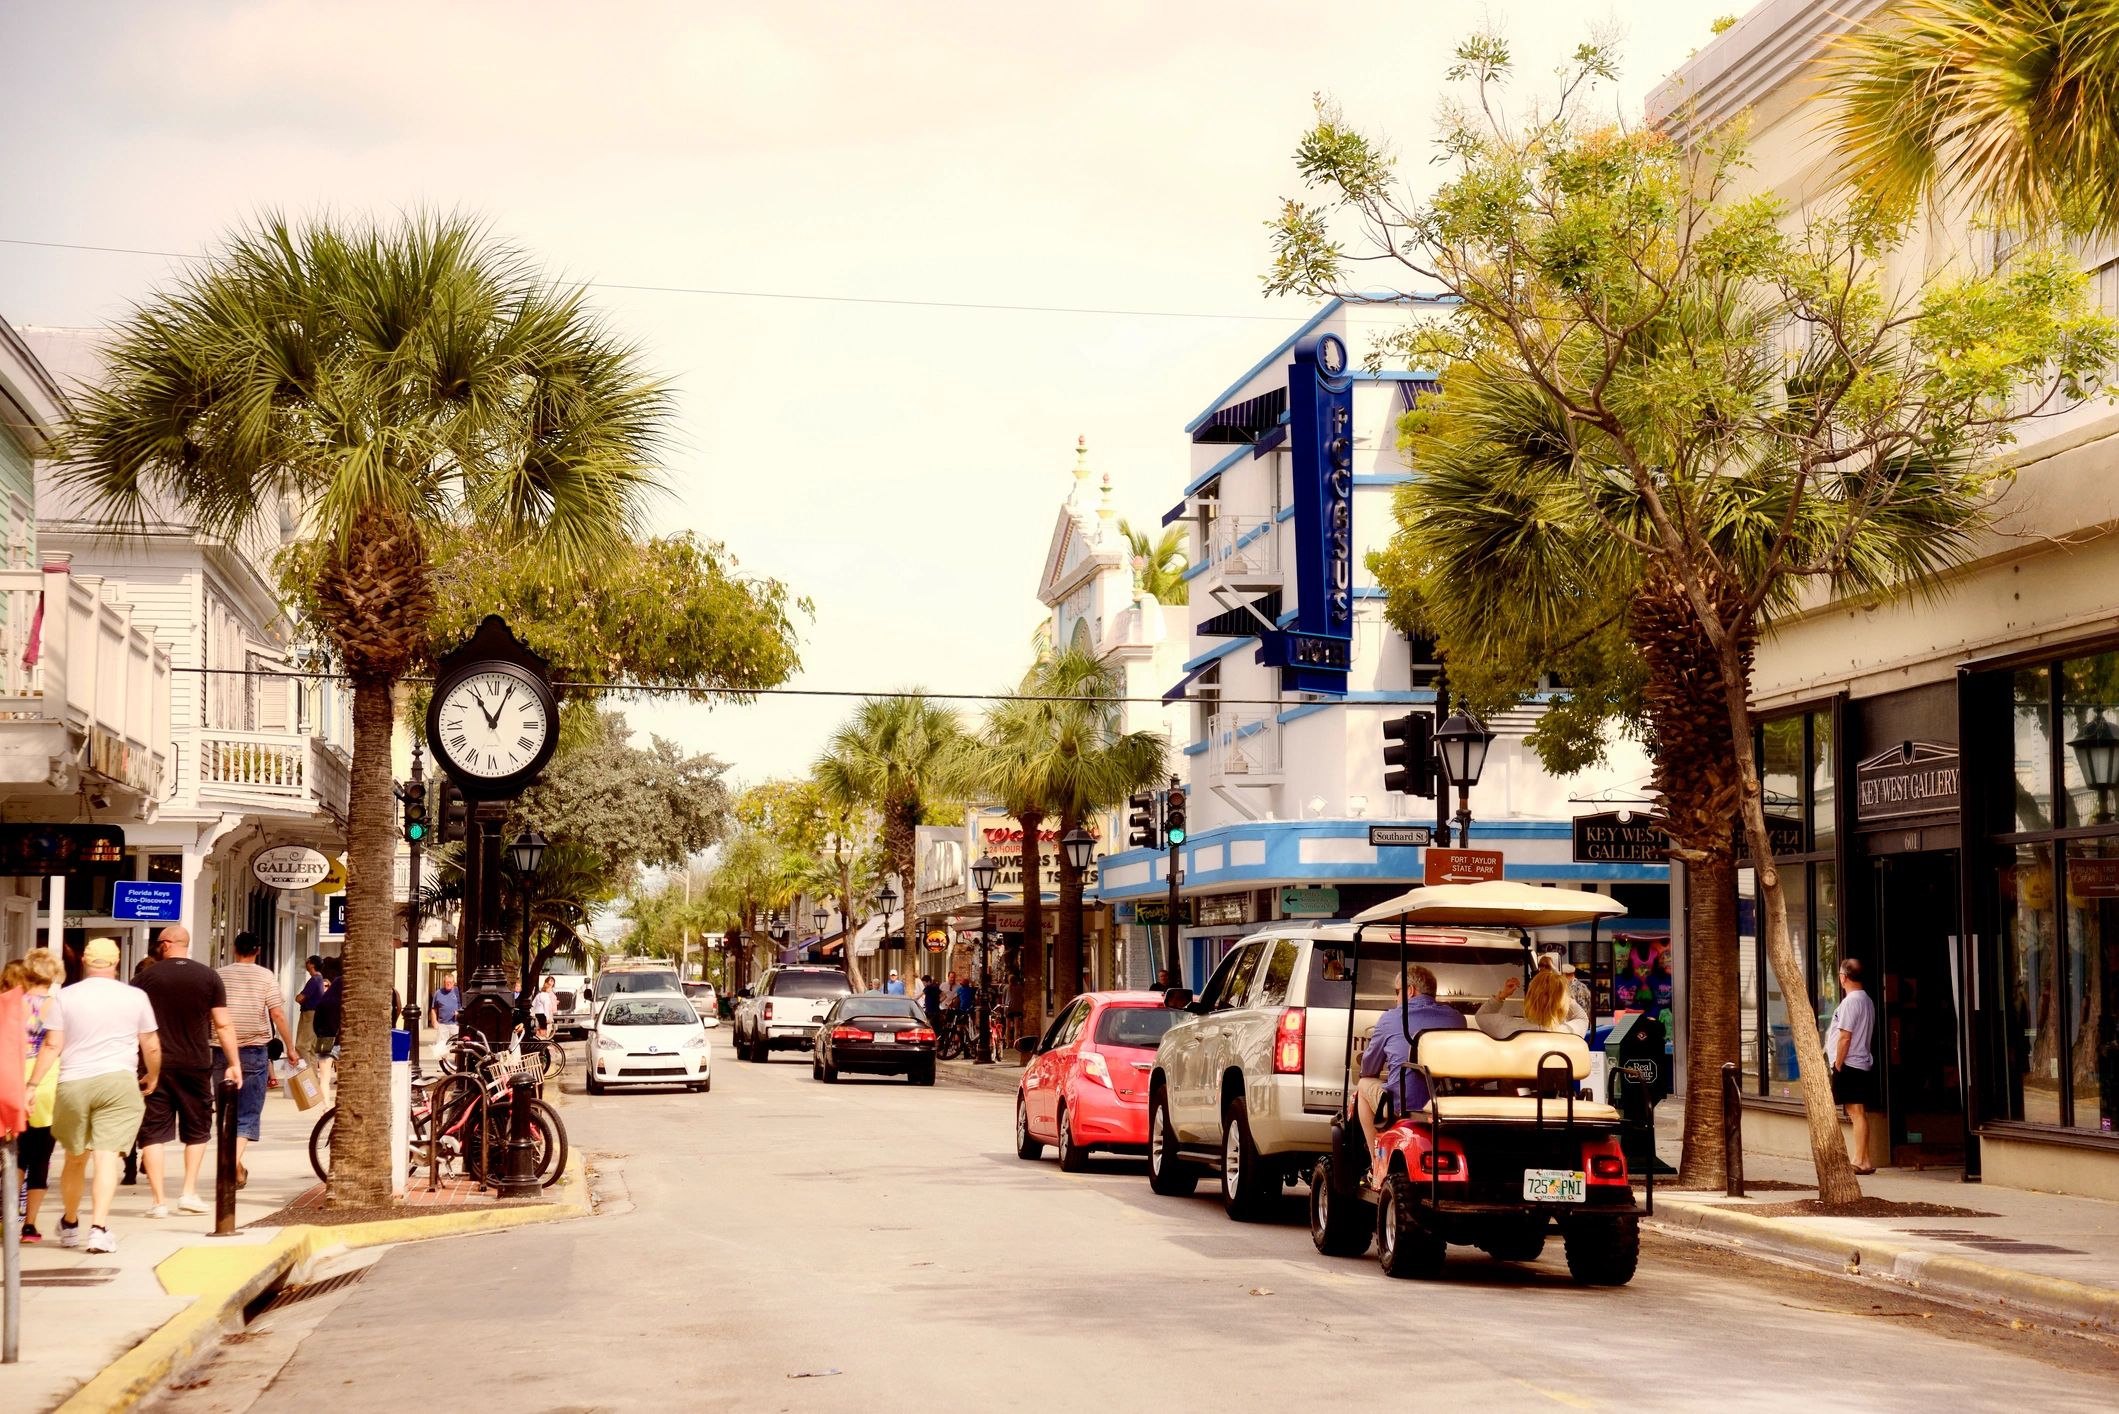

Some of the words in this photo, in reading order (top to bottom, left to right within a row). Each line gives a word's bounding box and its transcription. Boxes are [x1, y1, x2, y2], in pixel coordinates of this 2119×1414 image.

[486, 680, 500, 696] XII
[1861, 779, 1880, 806] KEY
[1881, 775, 1909, 802] WEST
[1910, 768, 1960, 799] GALLERY
[1376, 831, 1413, 841] Southard
[1415, 831, 1424, 841] St
[1586, 826, 1618, 842] KEY
[1621, 827, 1663, 843] WEST
[1904, 832, 1918, 850] 601
[999, 845, 1023, 853] HOUR
[1587, 843, 1663, 859] GALLERY
[1450, 856, 1467, 864] FORT
[1471, 856, 1497, 865] TAYLOR
[256, 862, 327, 874] GALLERY
[1452, 864, 1472, 873] STATE
[1476, 865, 1494, 873] PARK
[154, 890, 170, 898] Keys
[124, 897, 173, 905] Eco-Discovery
[999, 918, 1053, 931] Walgns
[1633, 1061, 1652, 1072] Real
[1527, 1178, 1548, 1194] 725
[1561, 1180, 1582, 1196] PNI
